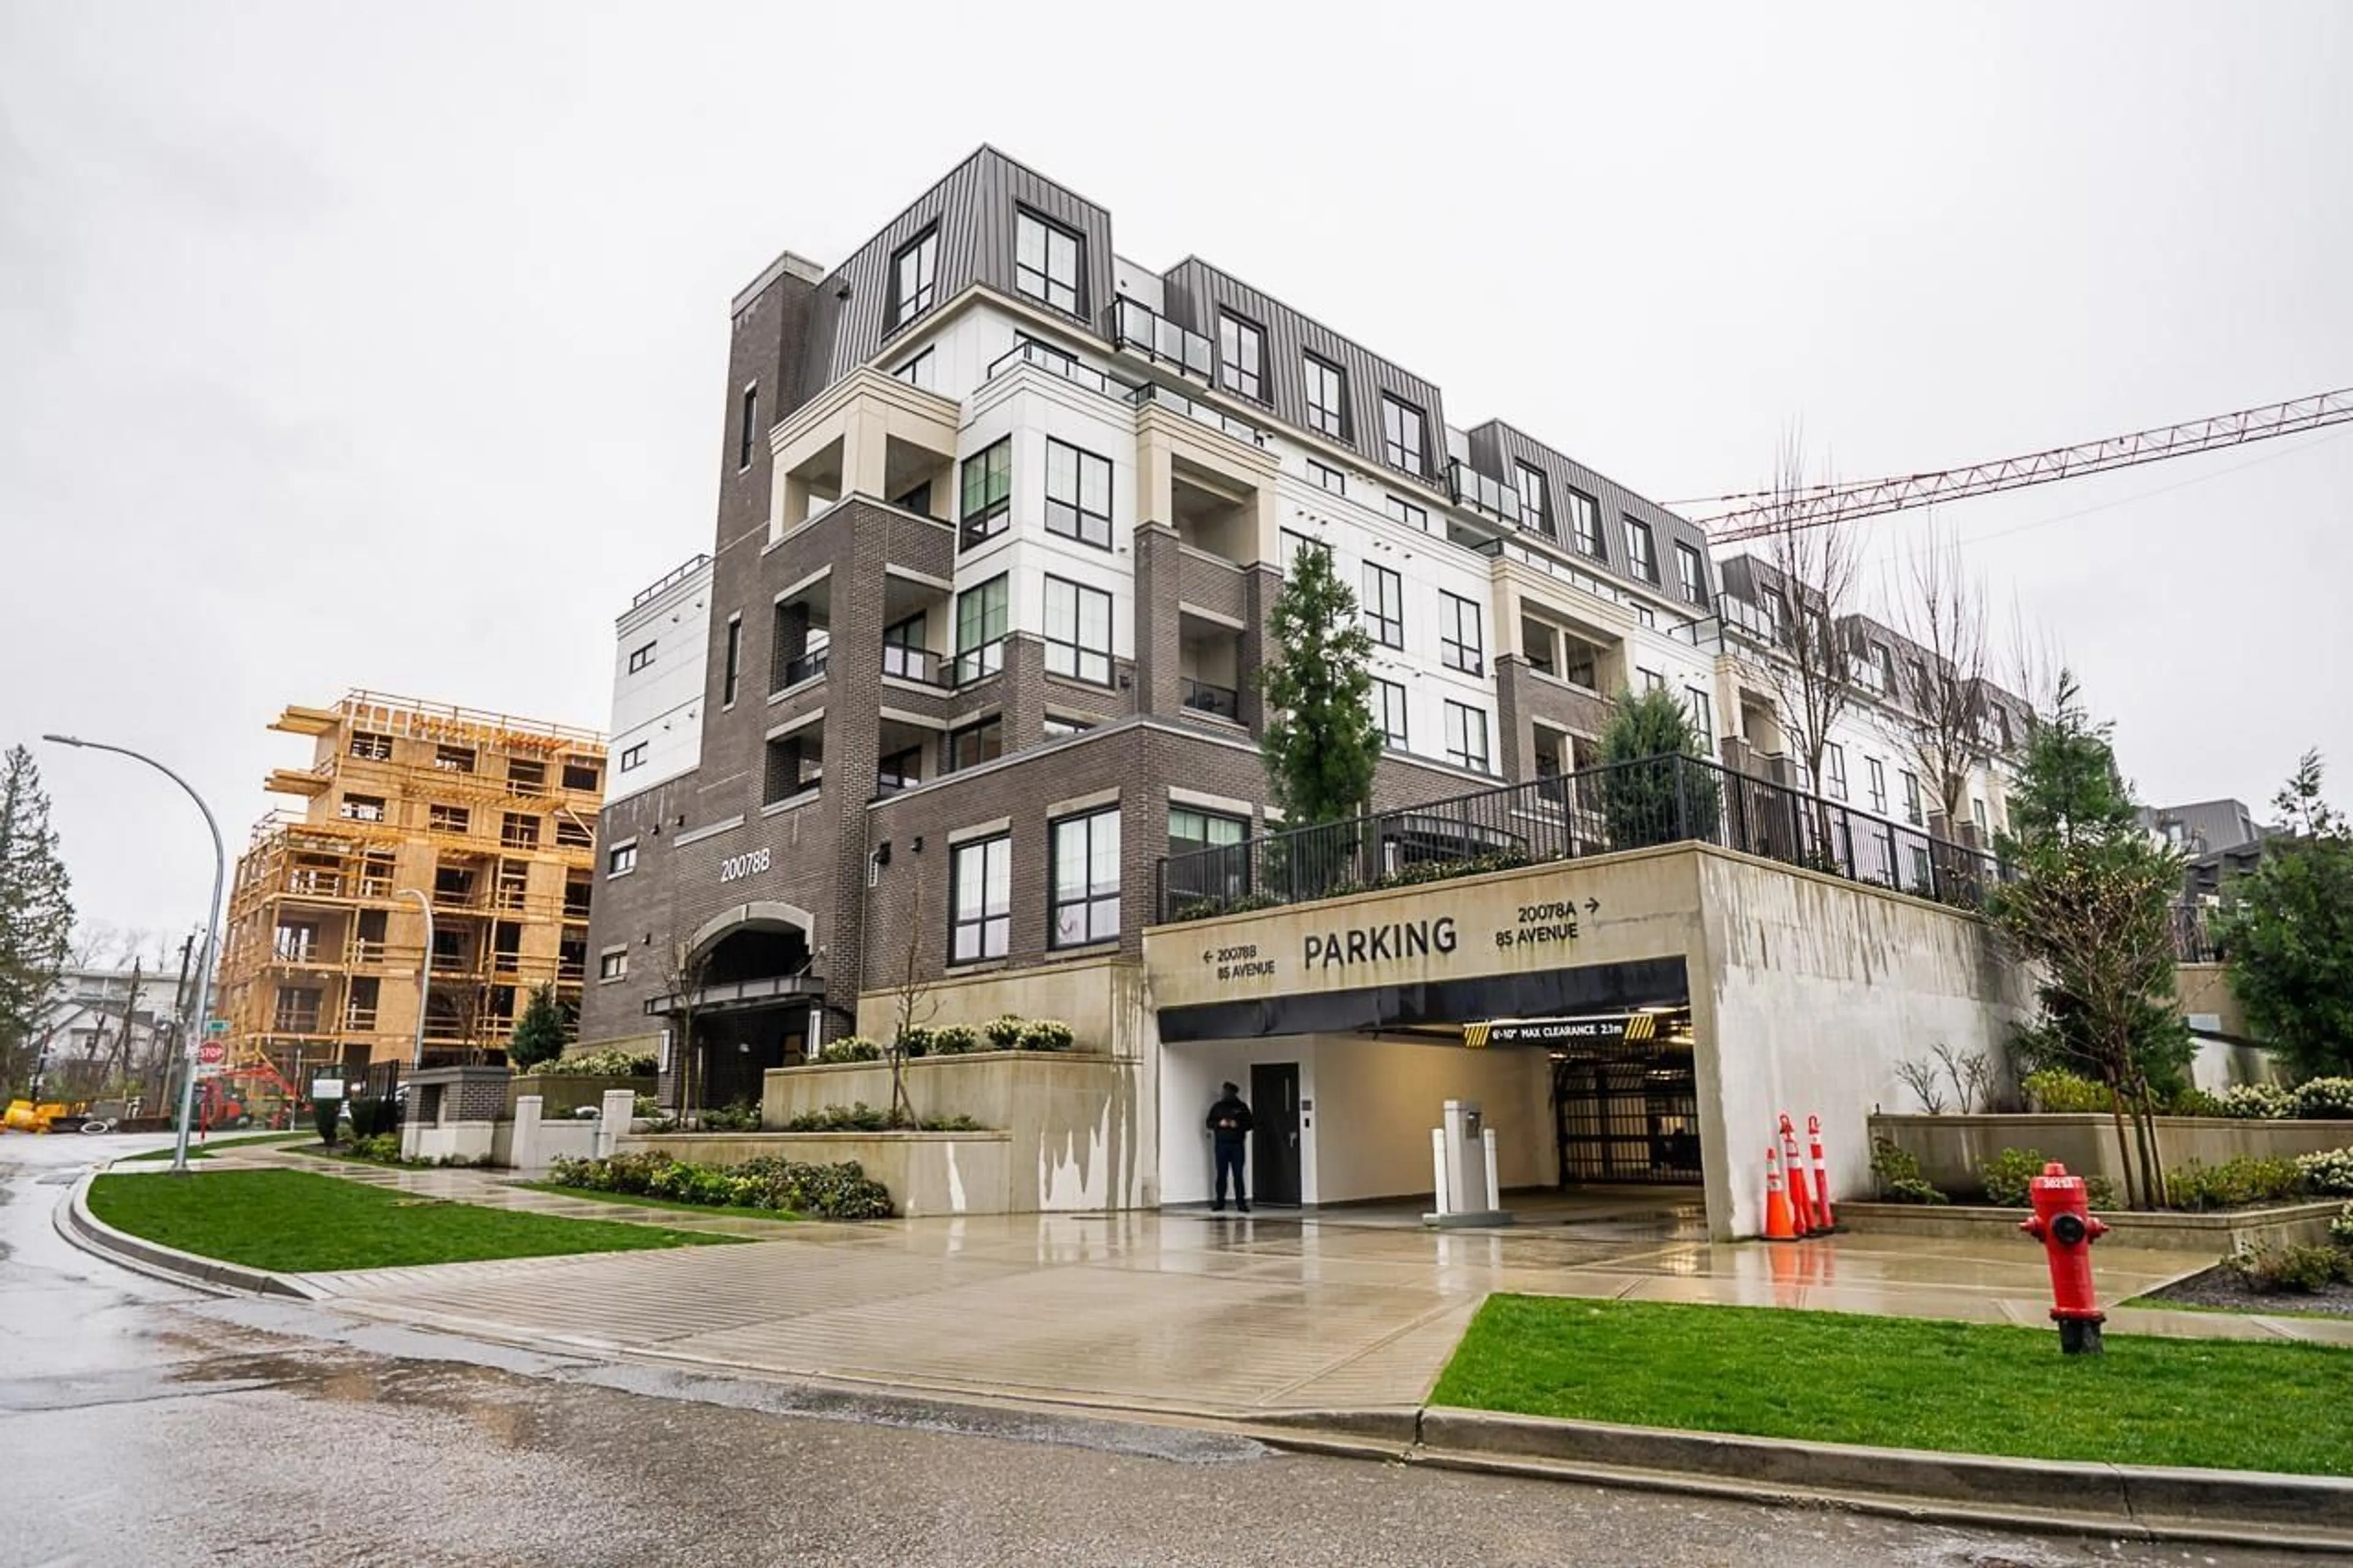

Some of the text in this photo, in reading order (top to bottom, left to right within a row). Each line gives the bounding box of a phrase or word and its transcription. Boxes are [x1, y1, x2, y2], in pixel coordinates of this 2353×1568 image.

[720, 847, 770, 883] 20078B
[1518, 900, 1577, 923] 20078A
[1305, 917, 1457, 971] PARKING
[1495, 922, 1578, 947] 85 AVENUE
[1218, 944, 1257, 963] 20078B
[1218, 959, 1275, 980] 85 AVENUE
[1521, 1028, 1542, 1039] MAX
[1543, 1024, 1596, 1037] CLEARANCE
[200, 1047, 222, 1058] STOP
